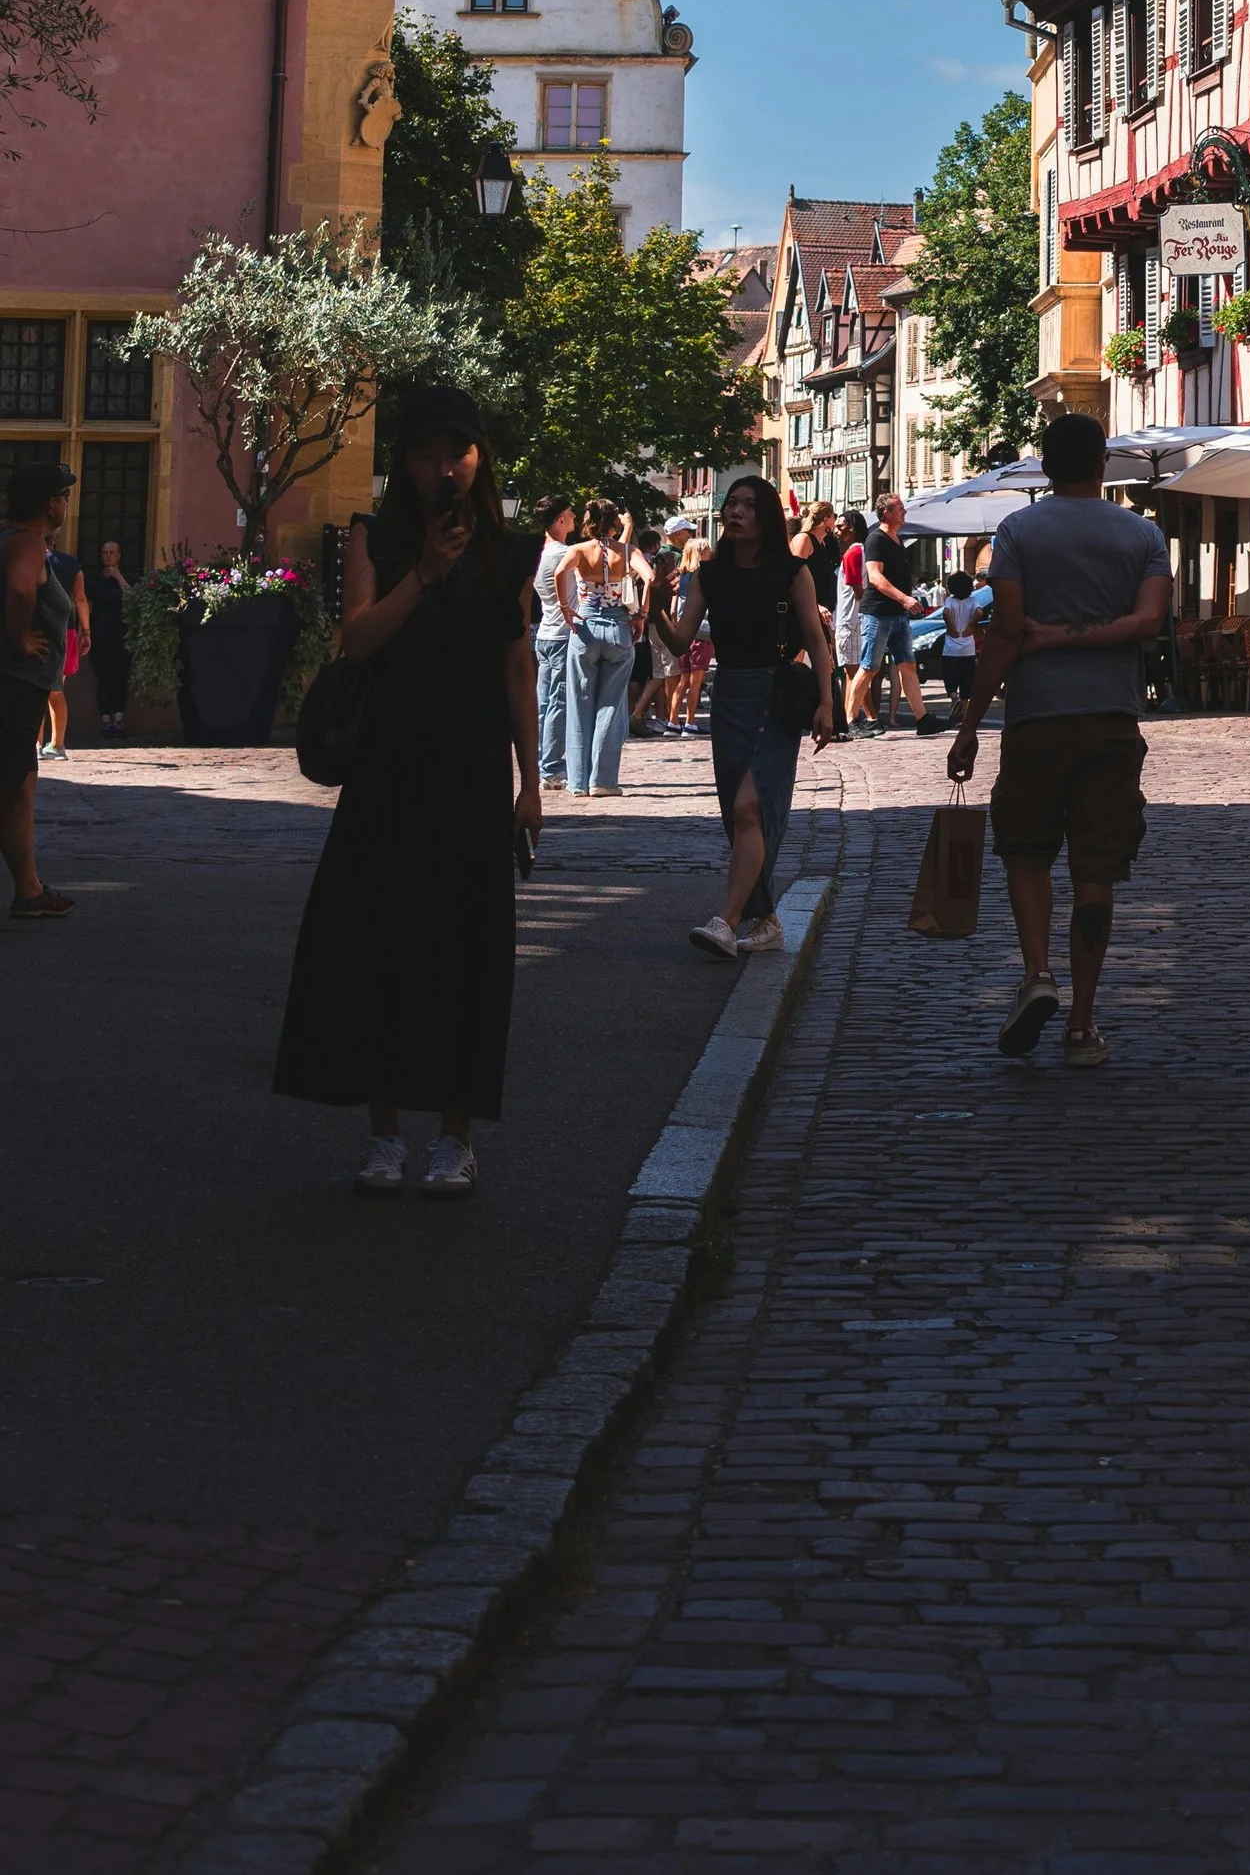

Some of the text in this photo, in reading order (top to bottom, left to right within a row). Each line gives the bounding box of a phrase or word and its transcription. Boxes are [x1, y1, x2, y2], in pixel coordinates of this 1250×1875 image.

[1178, 218, 1225, 231] Restaurant
[1213, 232, 1229, 242] Au
[1164, 236, 1239, 264] Fer Rouge
